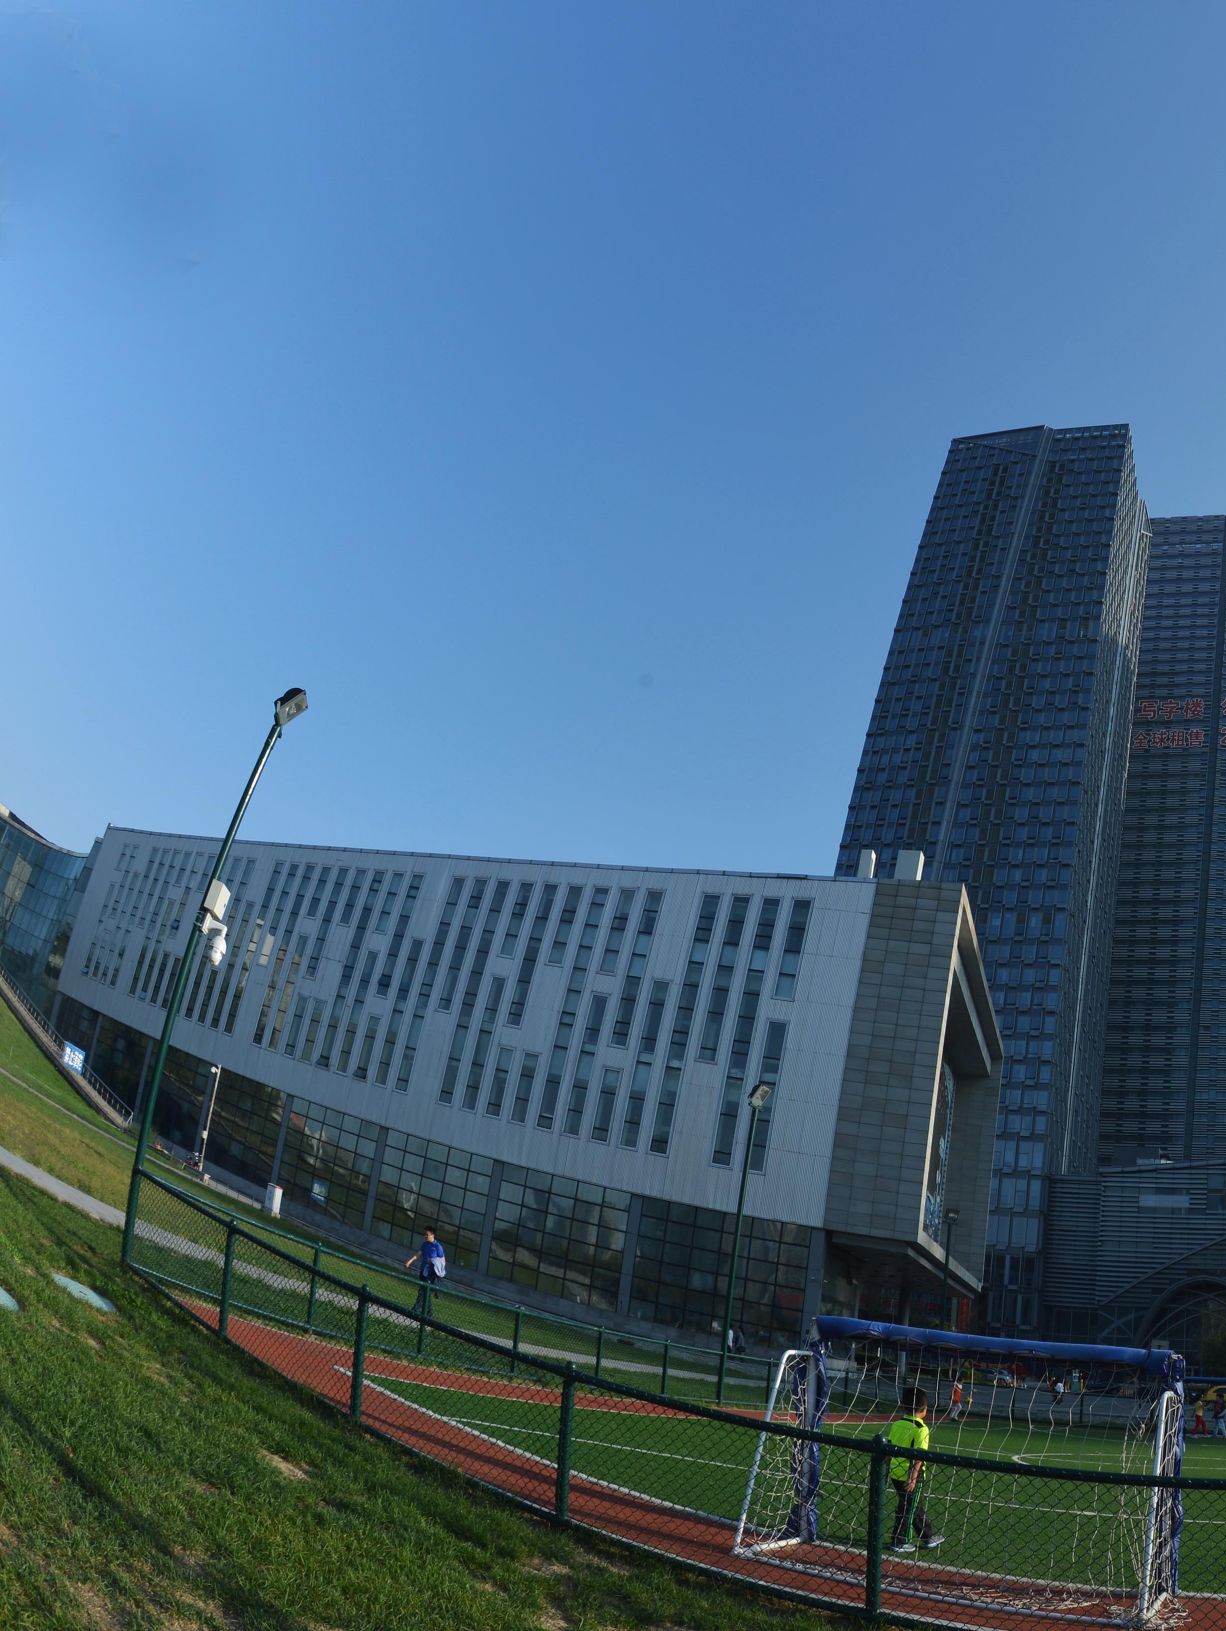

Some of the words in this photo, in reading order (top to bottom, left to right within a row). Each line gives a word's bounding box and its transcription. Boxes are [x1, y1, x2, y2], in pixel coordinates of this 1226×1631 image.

[1138, 699, 1204, 721] 写字楼
[1133, 729, 1204, 750] 全球租售
